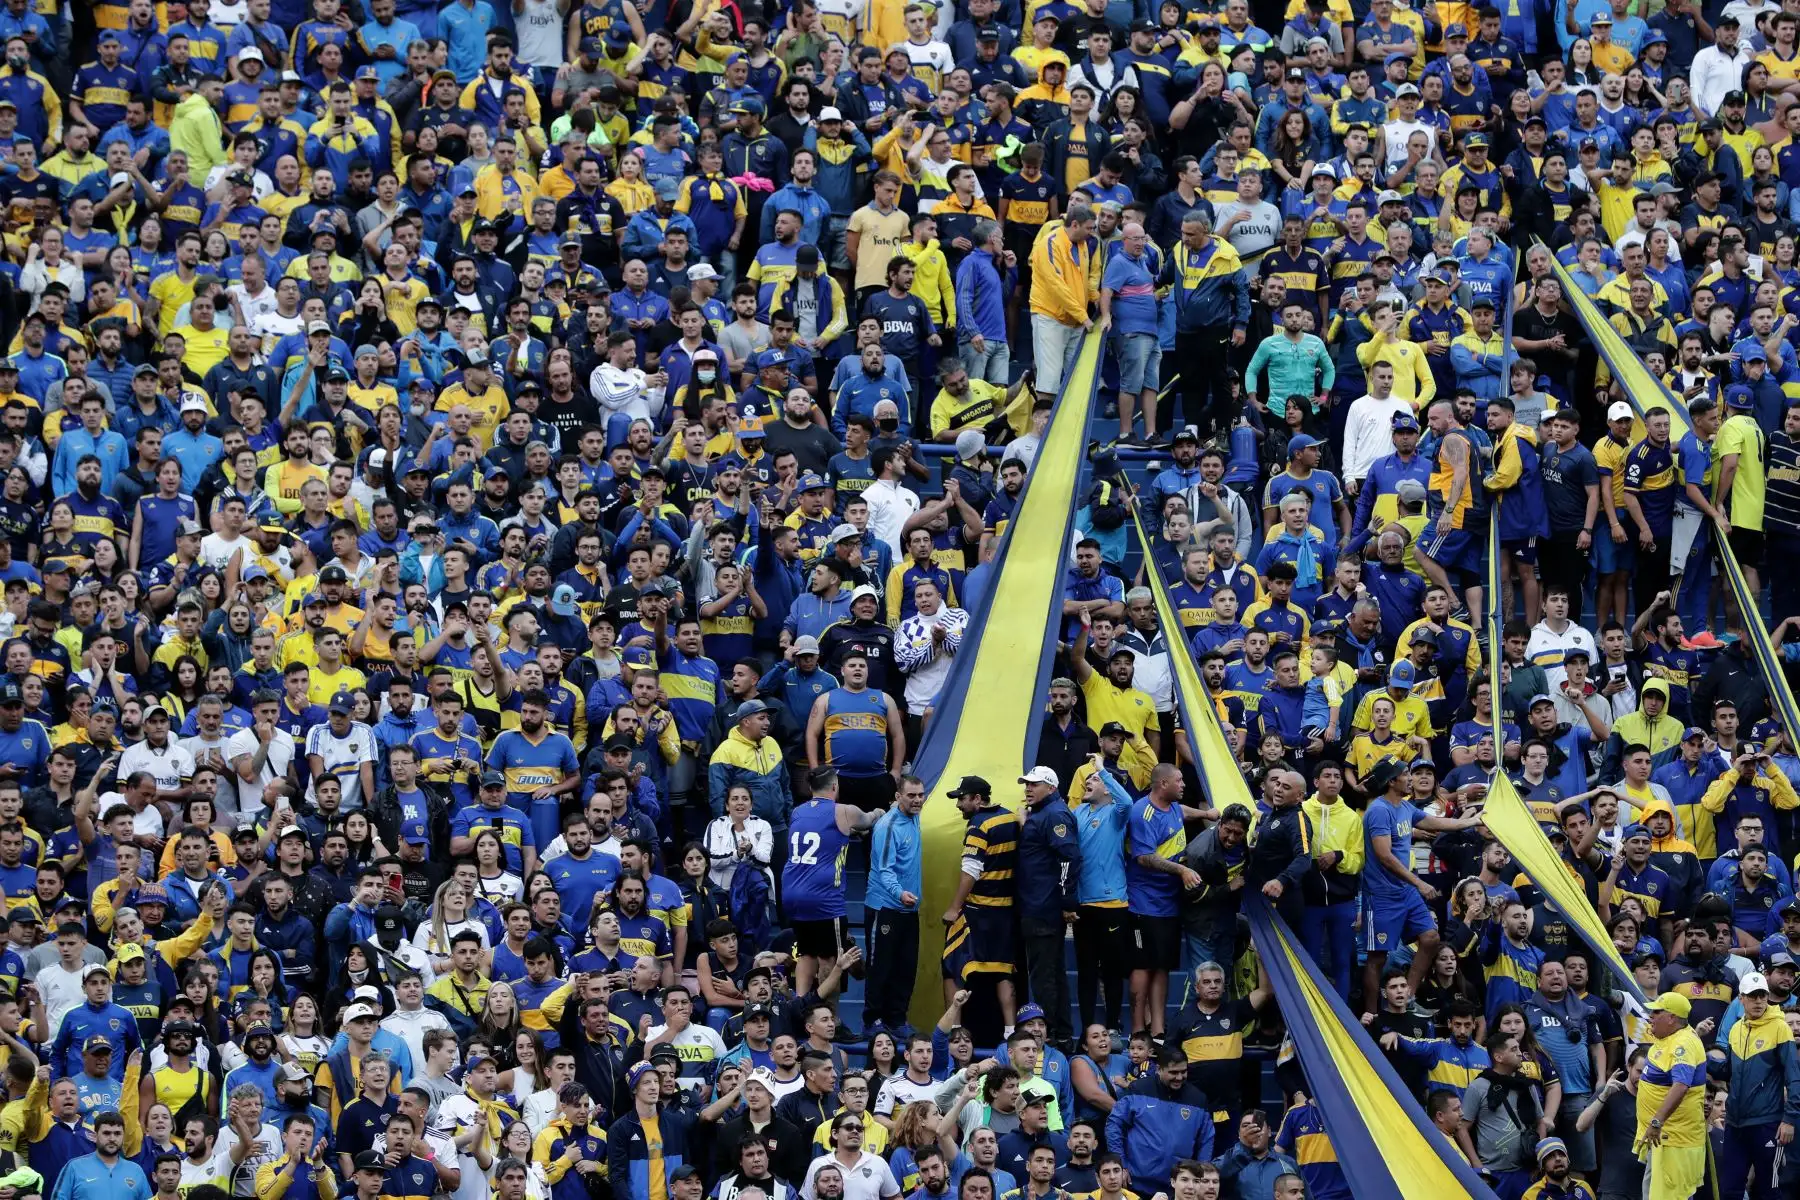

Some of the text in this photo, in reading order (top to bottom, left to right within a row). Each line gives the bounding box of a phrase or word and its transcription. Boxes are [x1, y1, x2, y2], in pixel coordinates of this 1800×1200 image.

[530, 15, 554, 26] BBVA
[1240, 225, 1271, 235] BBVA
[1467, 281, 1493, 293] BVA
[884, 321, 914, 333] BBVA
[619, 611, 639, 619] BBVA
[1188, 611, 1216, 619] QATAR
[718, 618, 744, 627] QATAR
[867, 648, 880, 658] LG
[367, 663, 391, 672] QATA
[92, 697, 116, 705] QATA
[1238, 694, 1262, 703] QATA
[842, 716, 876, 729] BOCA
[291, 725, 301, 735] 10
[517, 775, 553, 785] FIAT
[791, 832, 820, 864] 12
[1707, 987, 1721, 996] LG
[81, 1093, 120, 1109] BOCA
